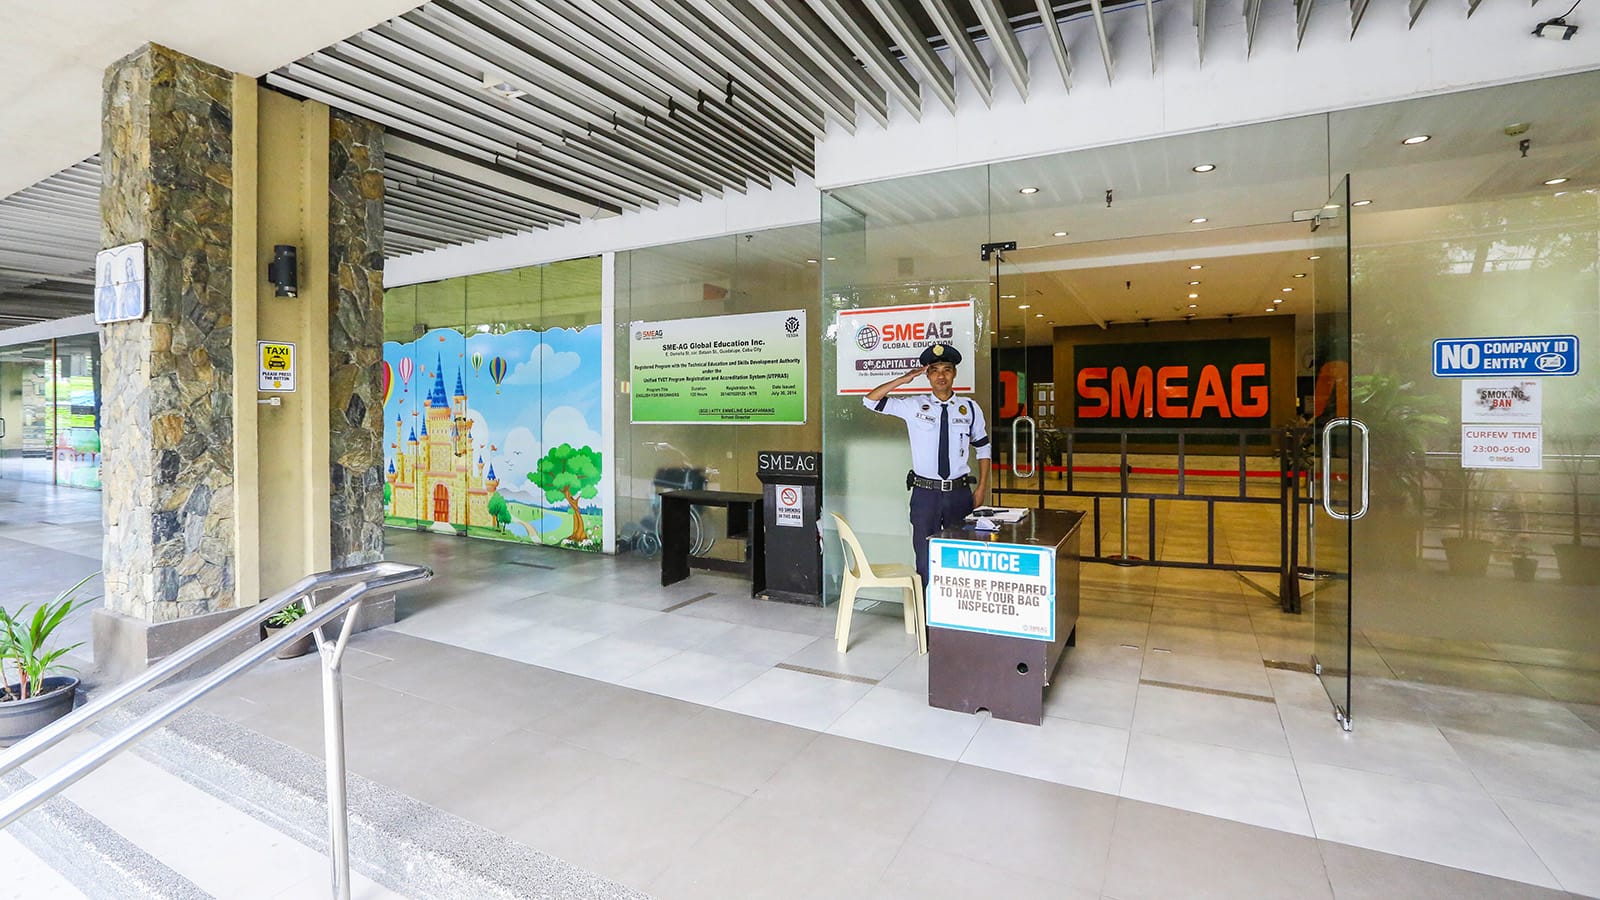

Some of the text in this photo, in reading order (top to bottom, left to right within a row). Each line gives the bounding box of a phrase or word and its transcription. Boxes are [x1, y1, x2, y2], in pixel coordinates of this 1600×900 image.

[642, 329, 663, 338] SMEAG
[882, 321, 953, 342] SMEAG
[265, 346, 288, 355] TAXI
[662, 342, 688, 352] SME-AG
[690, 341, 712, 350] Global
[714, 339, 749, 348] Education
[882, 341, 910, 350] GLOBAL
[1483, 340, 1569, 354] COMPANY ID
[876, 359, 908, 369] CAPITAL
[1441, 344, 1481, 370] NO
[1483, 357, 1528, 370] ENTRY
[1077, 363, 1269, 419] SMEAG
[1492, 399, 1512, 408] BAN
[1472, 445, 1530, 454] 23:00-05:00
[759, 454, 815, 471] SMEAG
[958, 550, 1020, 573] NOTICE
[934, 574, 1047, 597] PLEASE BE PREPARED
[940, 586, 1040, 607] TO HAVE YOUR BAG
[958, 600, 1020, 616] INSPECTED.
